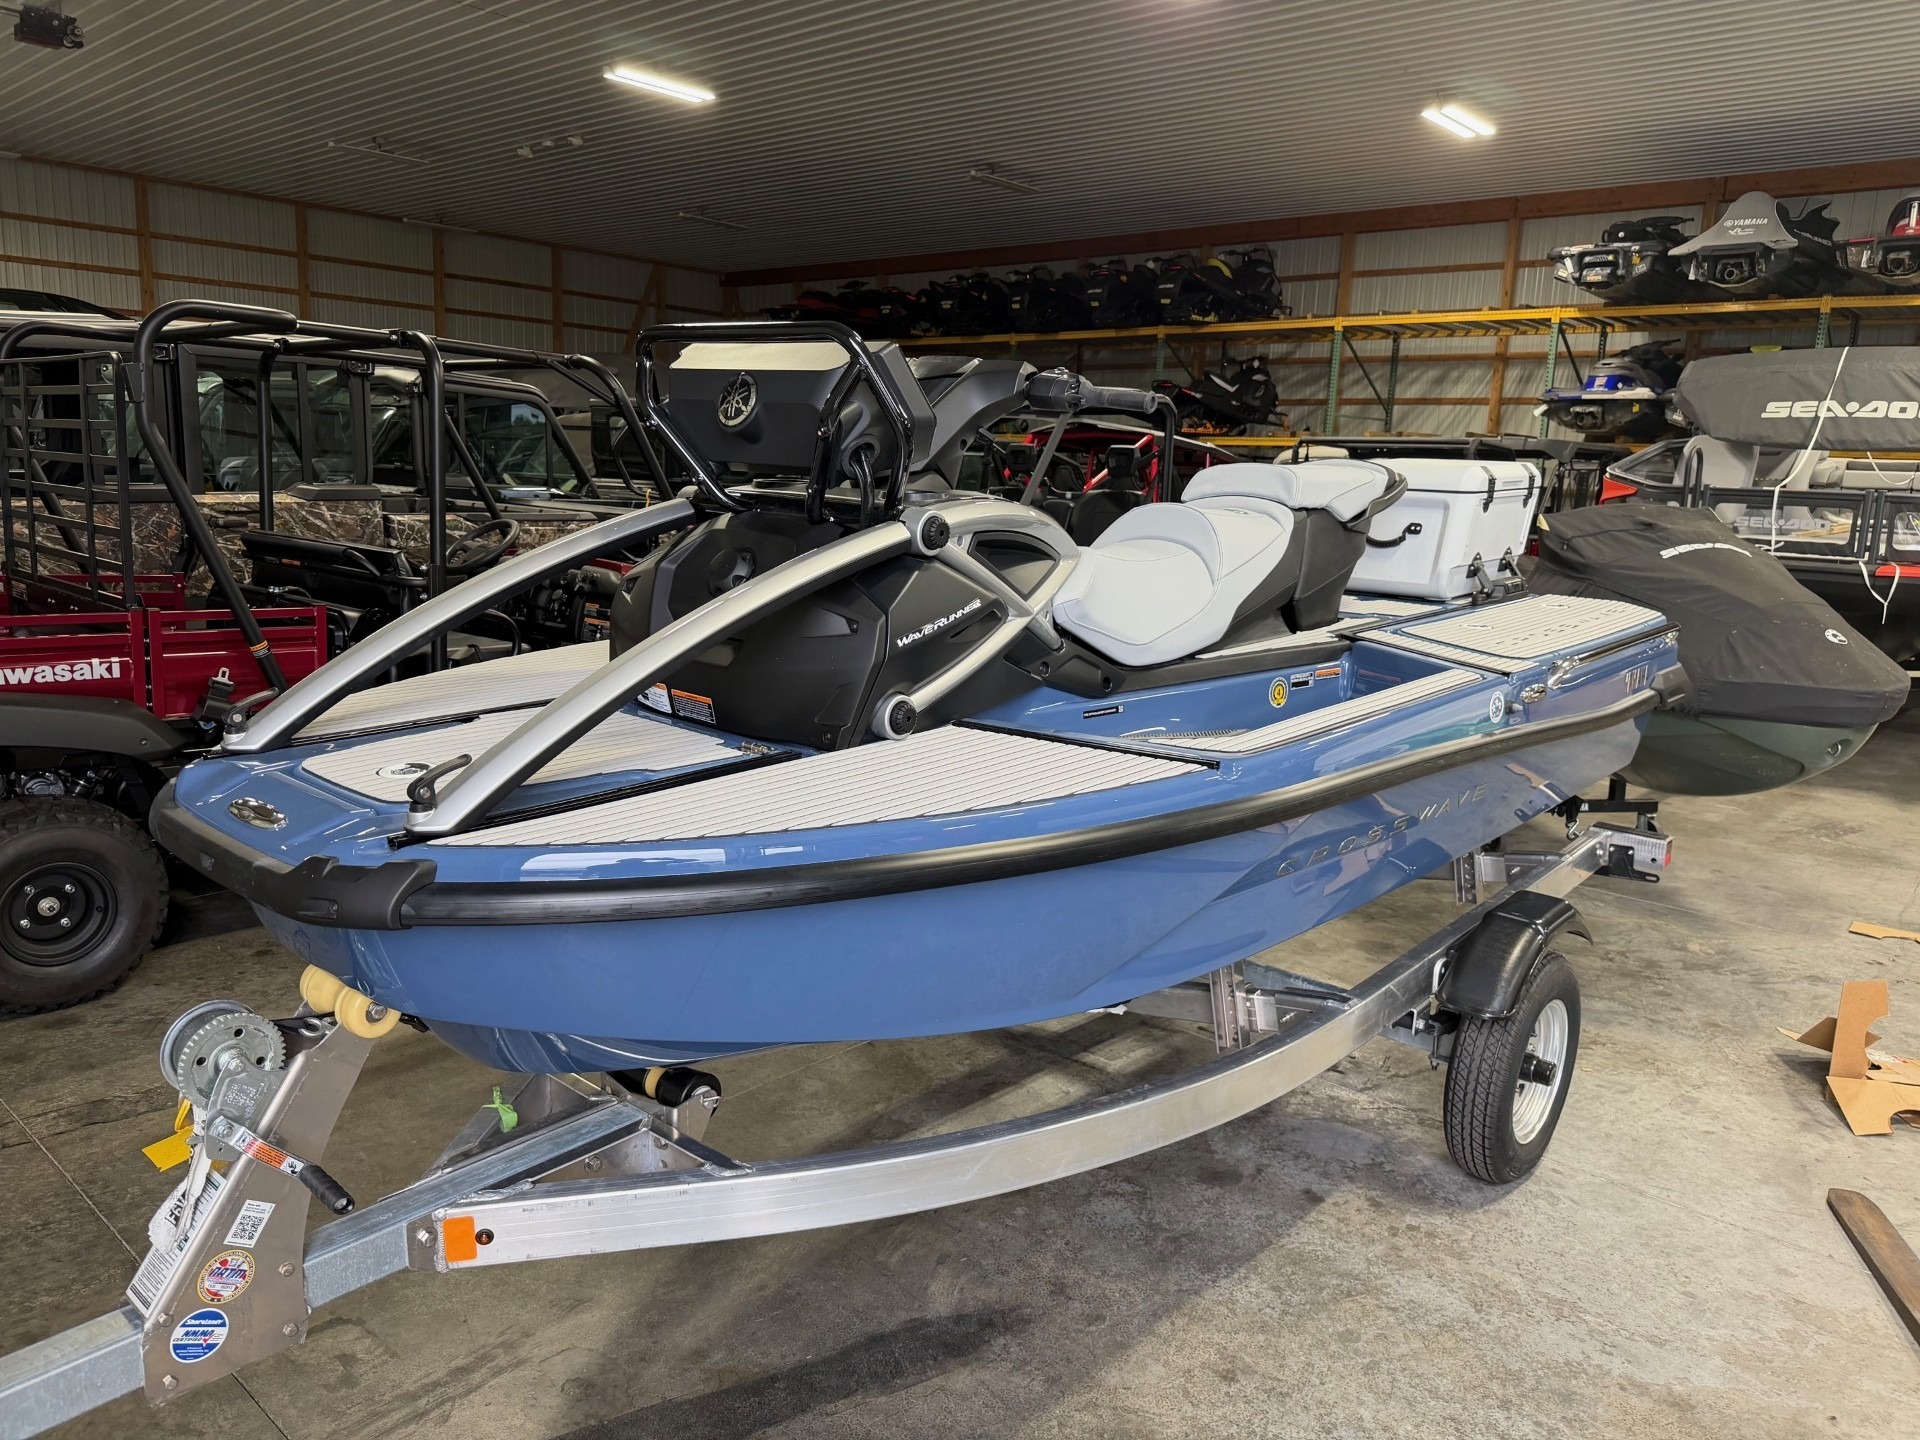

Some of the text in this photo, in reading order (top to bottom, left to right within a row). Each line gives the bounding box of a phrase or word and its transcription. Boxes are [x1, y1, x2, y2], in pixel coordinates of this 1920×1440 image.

[1734, 218, 1768, 226] YAMAHA
[1761, 401, 1920, 419] SEA•DO
[896, 598, 982, 647] WAVERUNNER
[0, 657, 120, 685] wasaki
